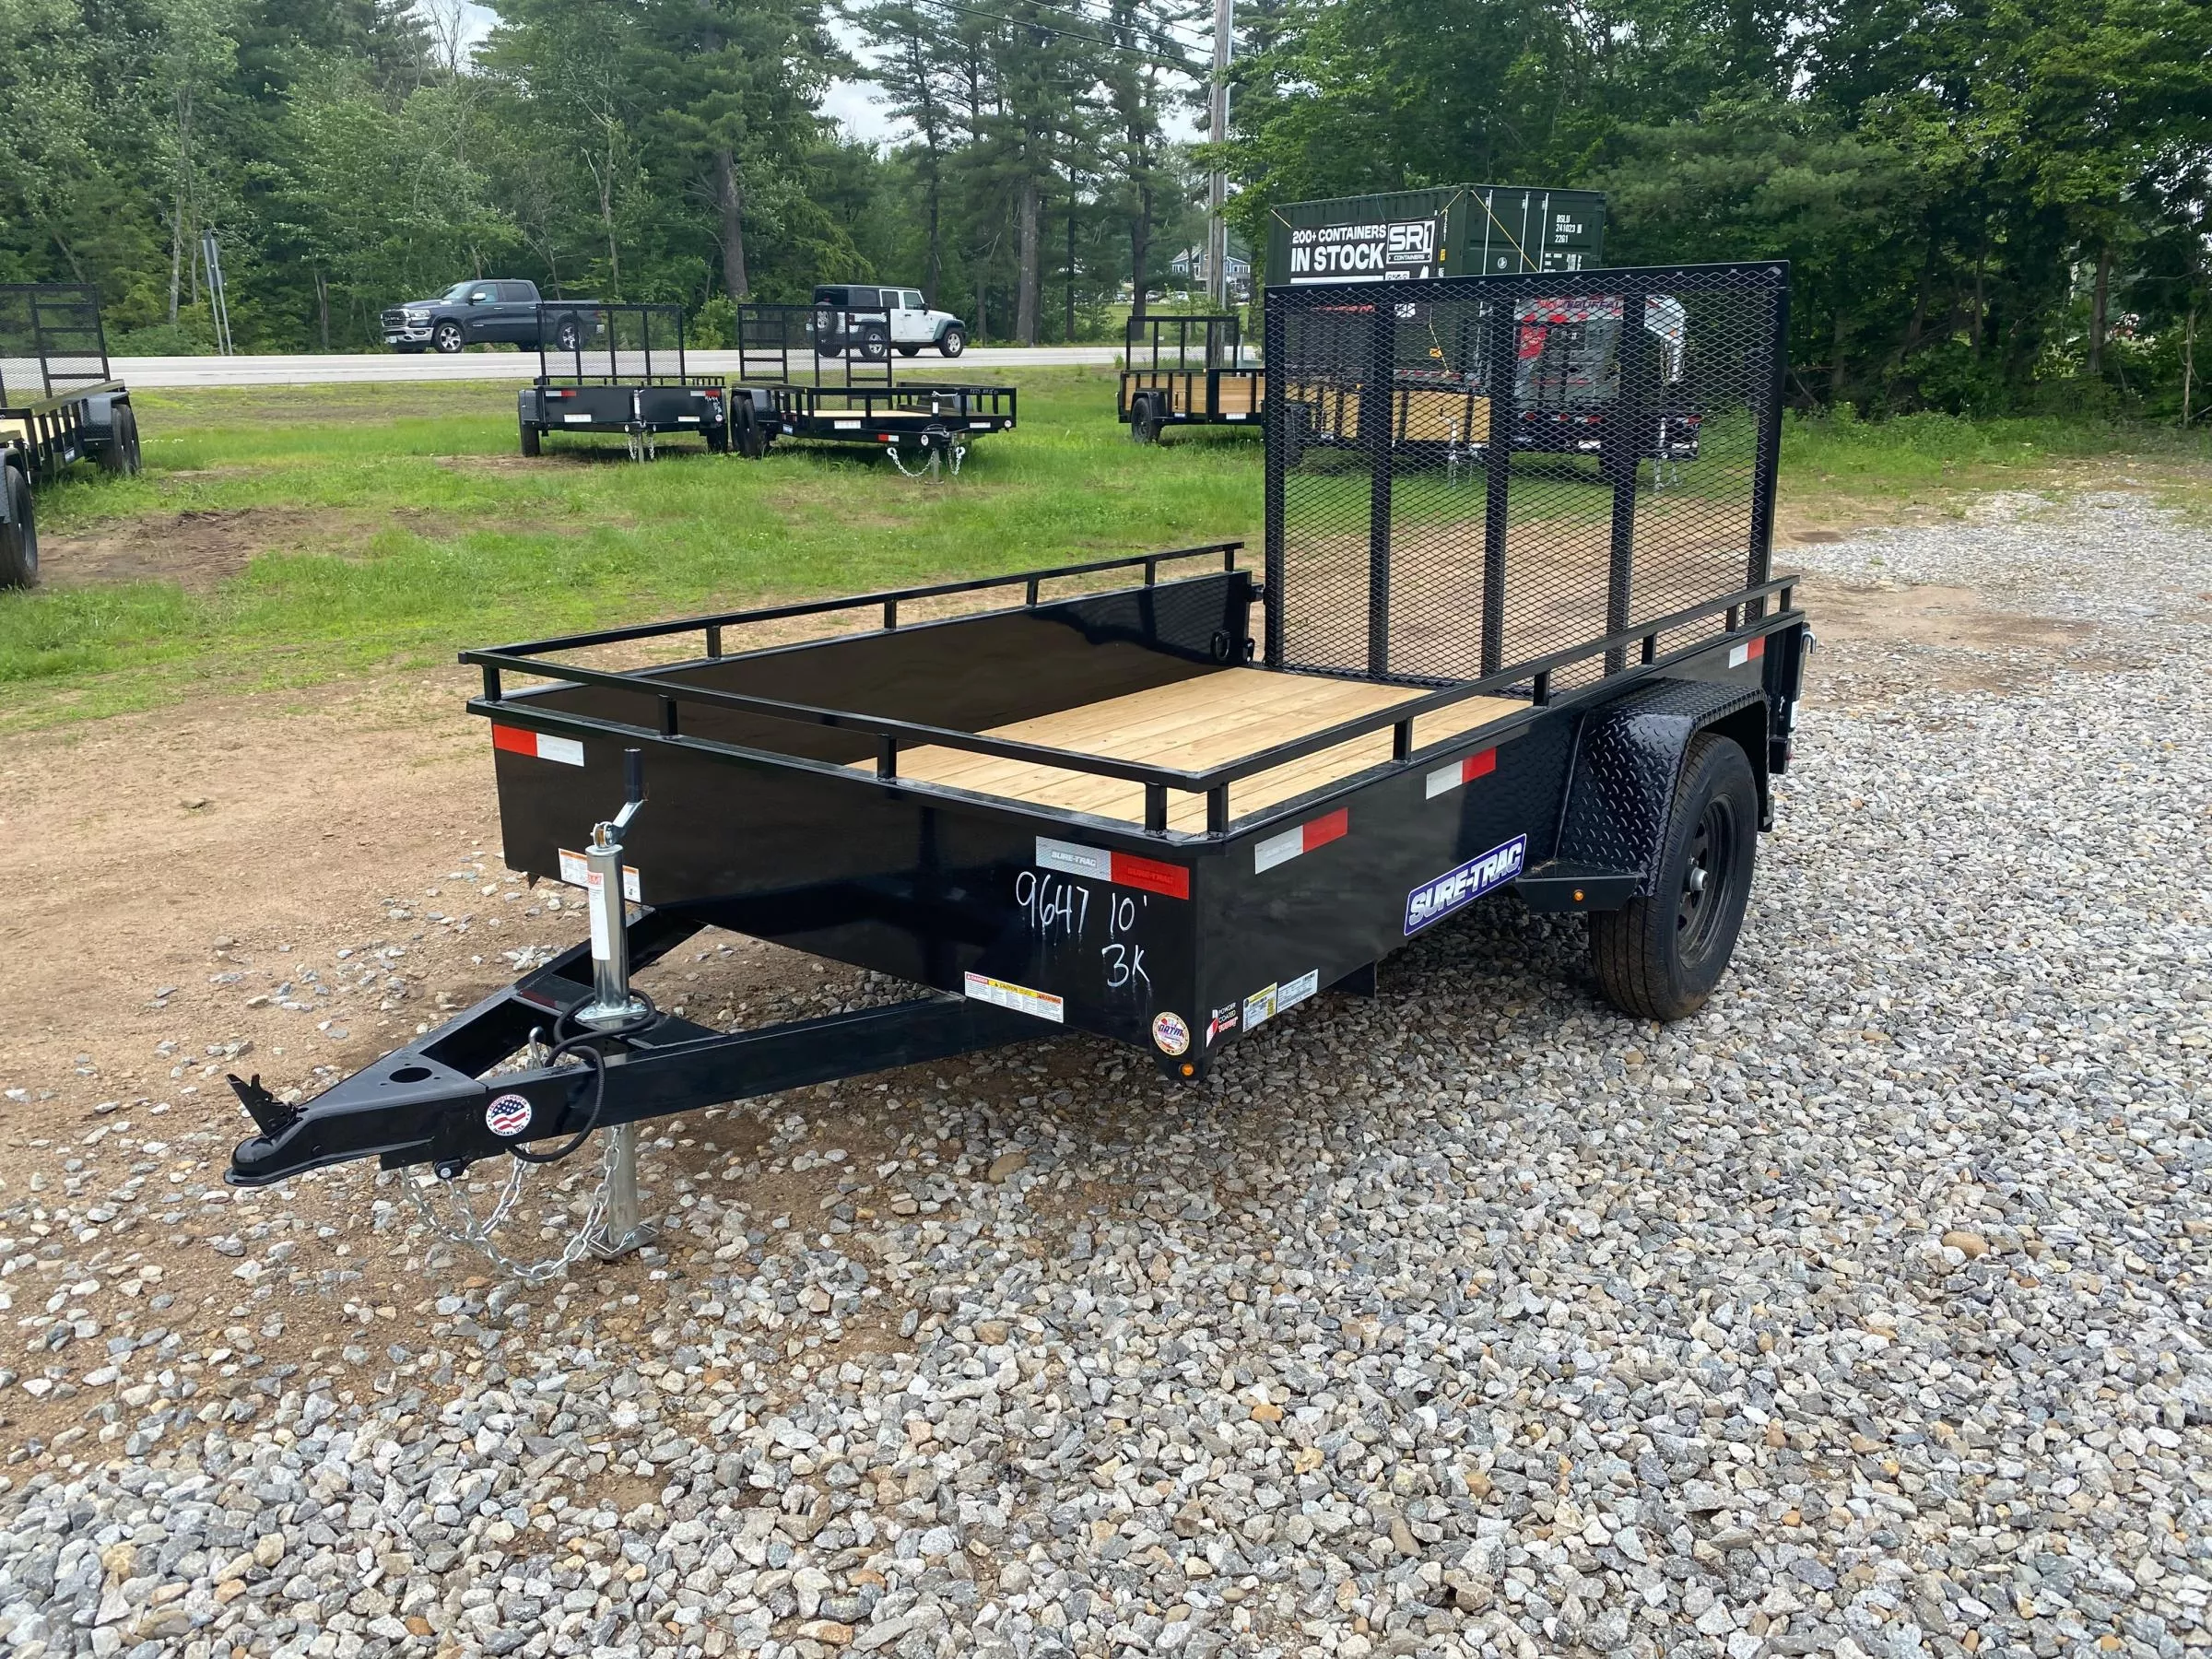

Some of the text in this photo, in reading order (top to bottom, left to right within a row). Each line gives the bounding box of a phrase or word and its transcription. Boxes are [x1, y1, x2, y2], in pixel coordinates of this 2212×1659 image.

[1292, 224, 1387, 244] 200+ CONTAINERS
[1290, 242, 1385, 272] IN STOCK
[1393, 253, 1426, 262] CONTAINERS
[1051, 850, 1097, 867] SURE-TRAC
[1408, 841, 1524, 926] SURE-TRAC
[1016, 871, 1089, 935] 9647
[1101, 943, 1150, 987] 3K
